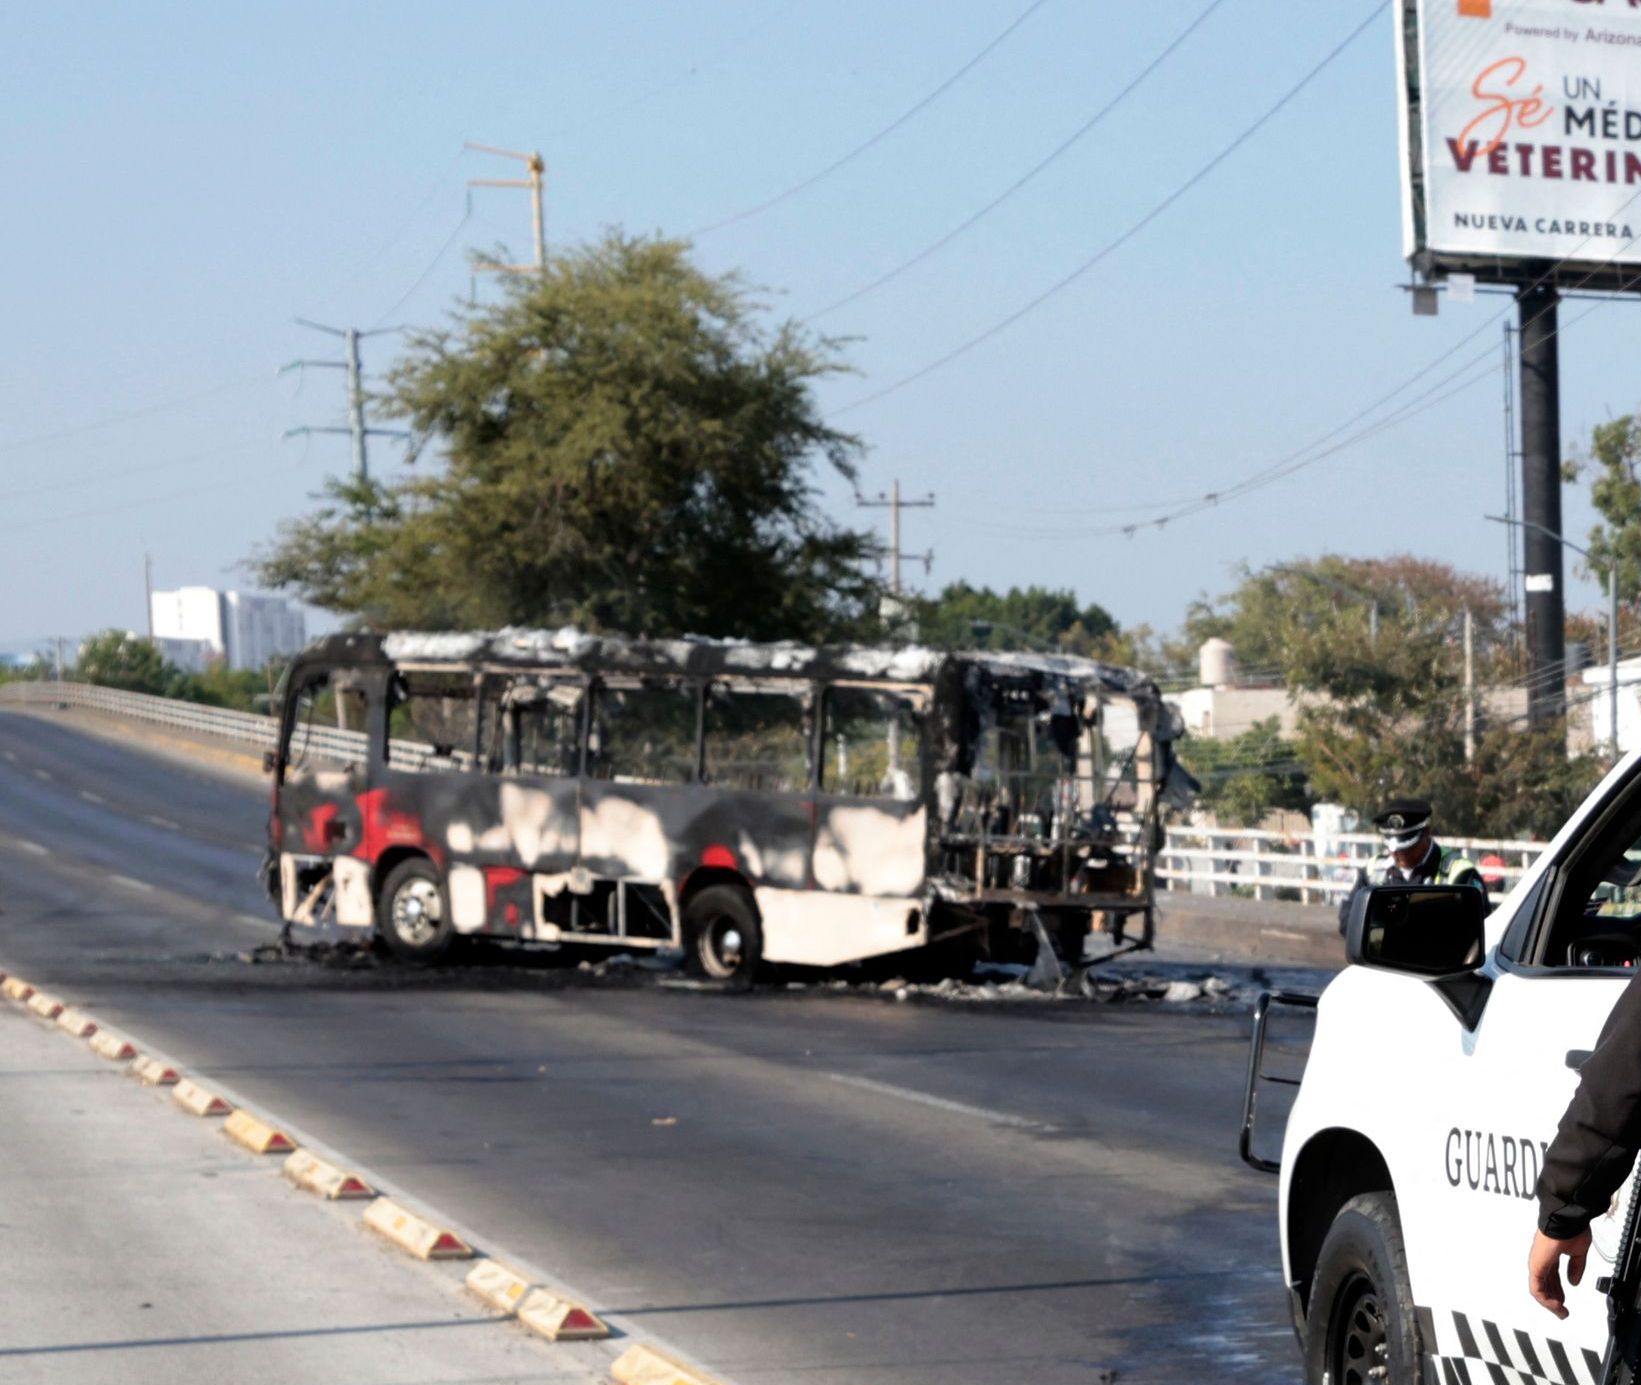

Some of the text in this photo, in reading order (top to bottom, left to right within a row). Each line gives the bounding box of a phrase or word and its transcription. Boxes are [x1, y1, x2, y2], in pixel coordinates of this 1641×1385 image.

[1503, 22, 1560, 39] Powered
[1563, 27, 1579, 42] by
[1563, 75, 1602, 100] UN
[1457, 56, 1554, 157] Sé
[1454, 213, 1634, 239] NUEVA CARRERA
